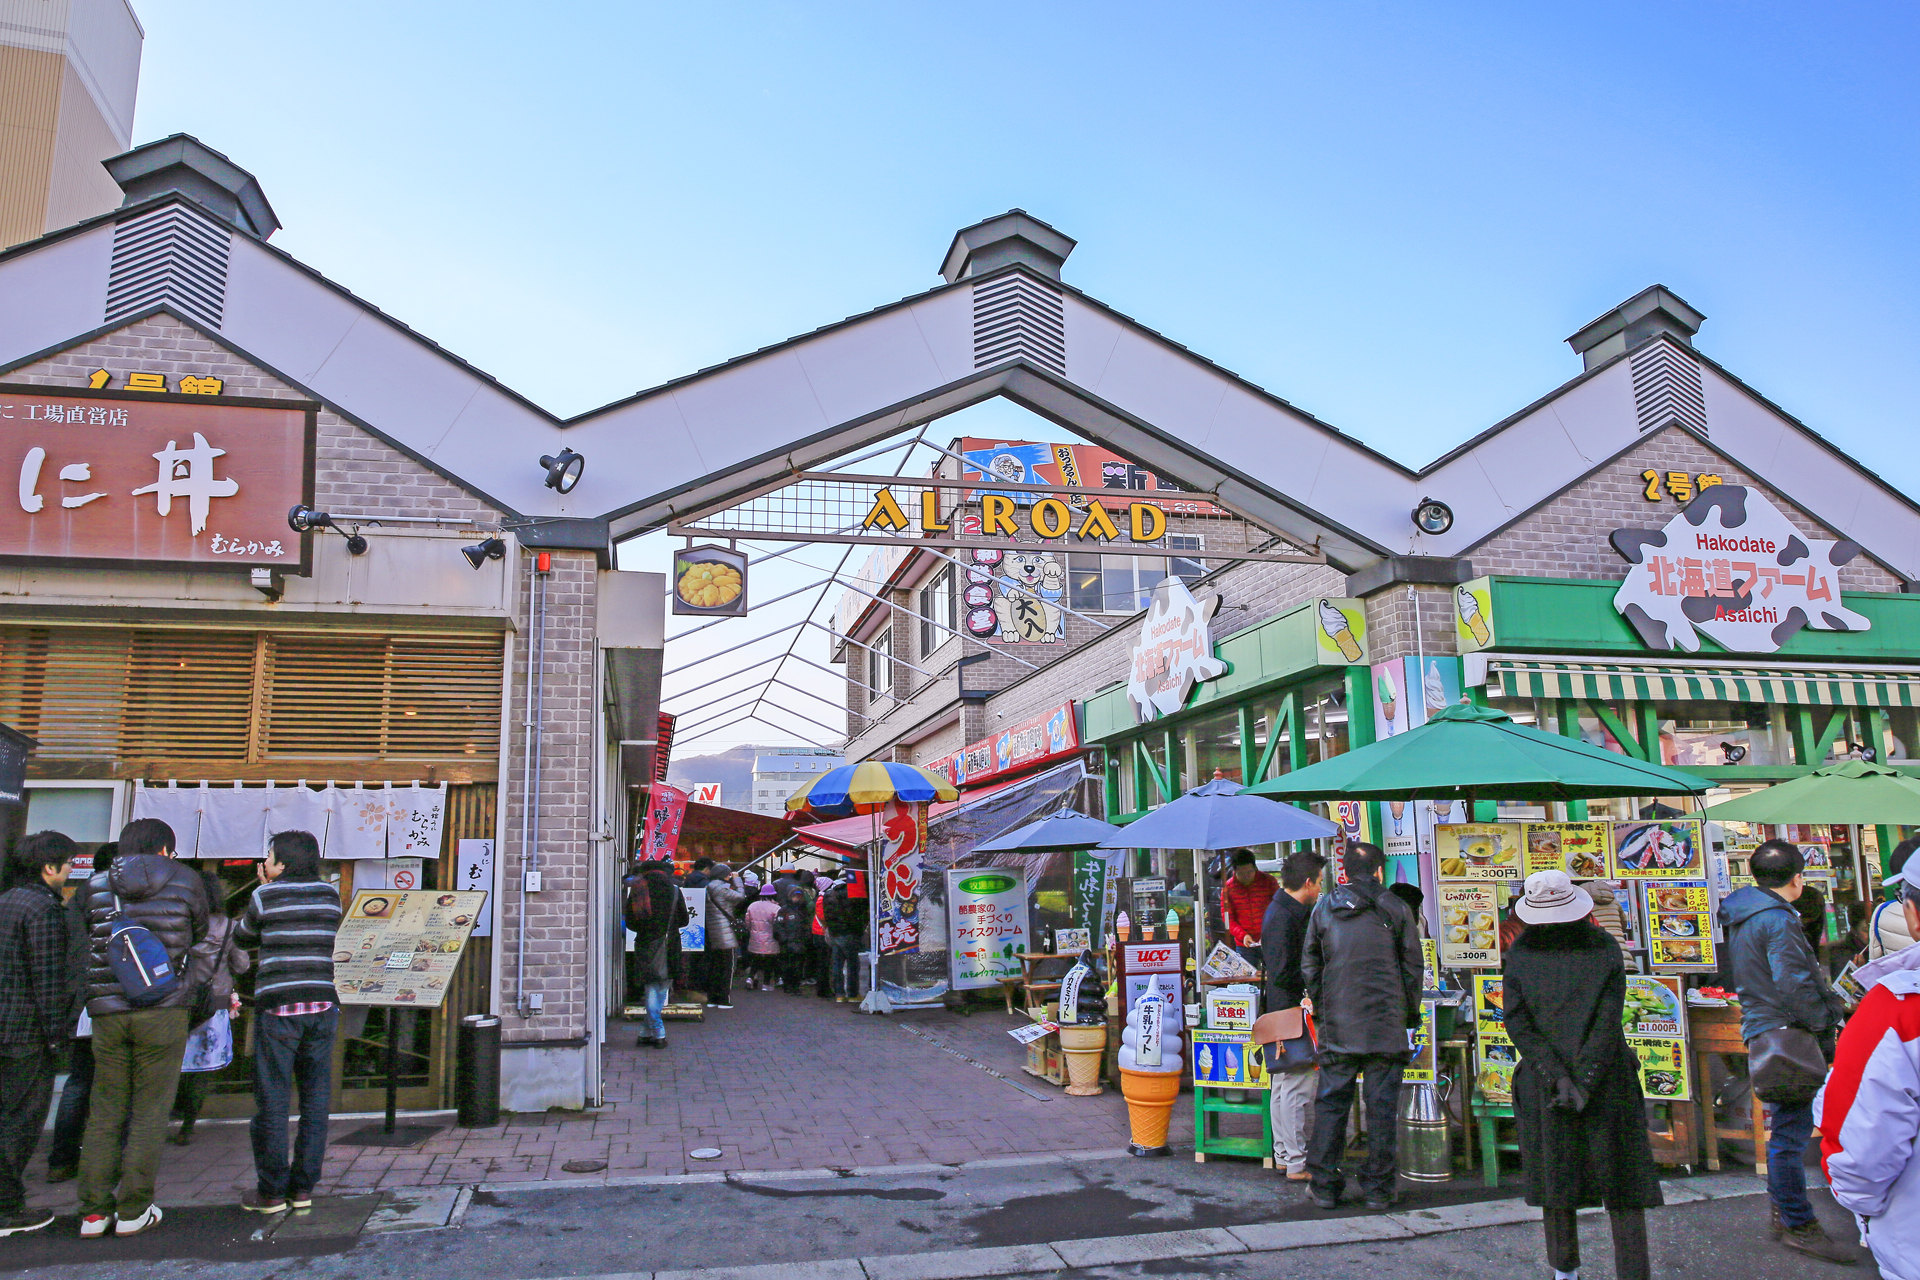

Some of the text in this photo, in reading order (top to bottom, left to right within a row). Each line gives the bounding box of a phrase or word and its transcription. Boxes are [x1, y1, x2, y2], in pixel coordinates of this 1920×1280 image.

[22, 404, 129, 427] 工場直営店
[19, 432, 240, 537] に丼
[1057, 447, 1083, 505] おっちゃん店
[863, 487, 1168, 543] AL ROAD
[210, 533, 285, 558] むらかみ
[1695, 533, 1777, 554] Hakodate
[1647, 555, 1833, 602] 北海道ファーム
[1015, 599, 1044, 638] 大八
[1713, 604, 1778, 625] Asaichi
[1150, 613, 1182, 641] Hakodate
[1134, 630, 1206, 683] 北海道ファーム
[1156, 673, 1182, 694] Asaichi
[408, 810, 430, 847] むらかみ
[481, 842, 491, 865] うに
[1481, 869, 1518, 878] 300円
[1445, 893, 1490, 901] じゃがバター
[958, 903, 996, 915] 酪農家の
[977, 914, 1013, 925] 手づくり
[879, 918, 919, 951] 直売
[957, 925, 1023, 939] アイスクリーム
[1462, 952, 1487, 960] 300円
[1217, 1006, 1246, 1018] 試食中
[1142, 1005, 1154, 1055] 牛乳ソフト
